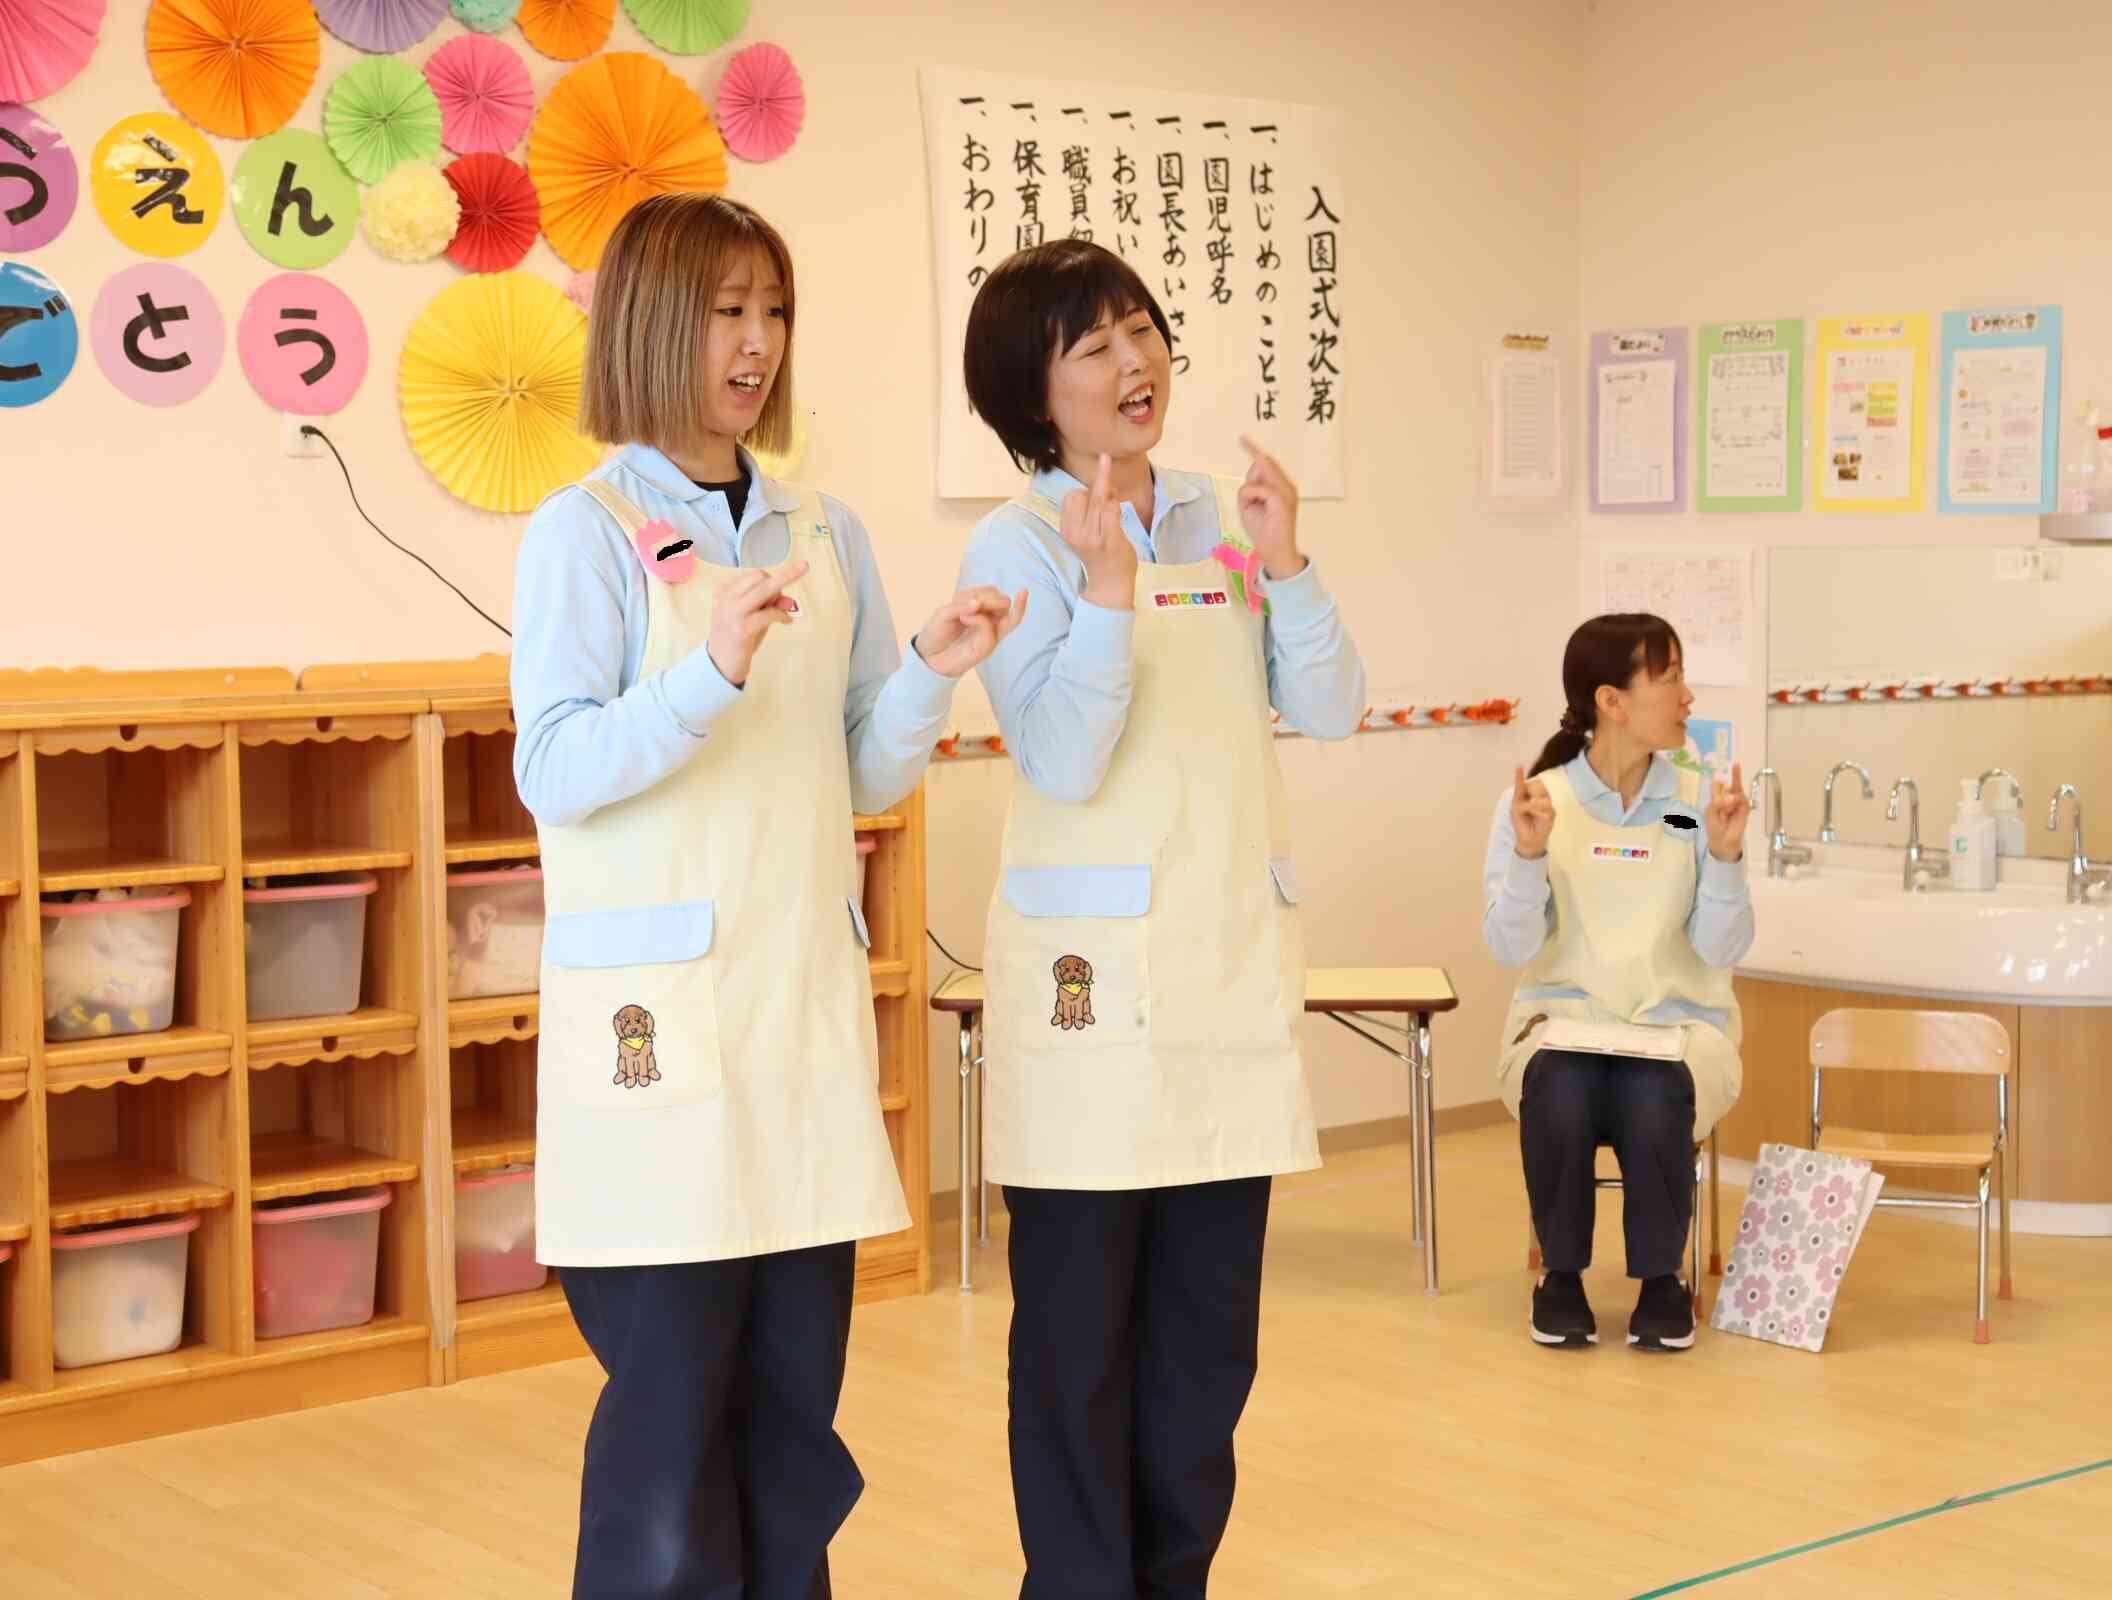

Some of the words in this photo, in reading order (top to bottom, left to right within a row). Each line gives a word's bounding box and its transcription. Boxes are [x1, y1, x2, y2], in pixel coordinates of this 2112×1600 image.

[1304, 185, 1341, 425] 入園式次第
